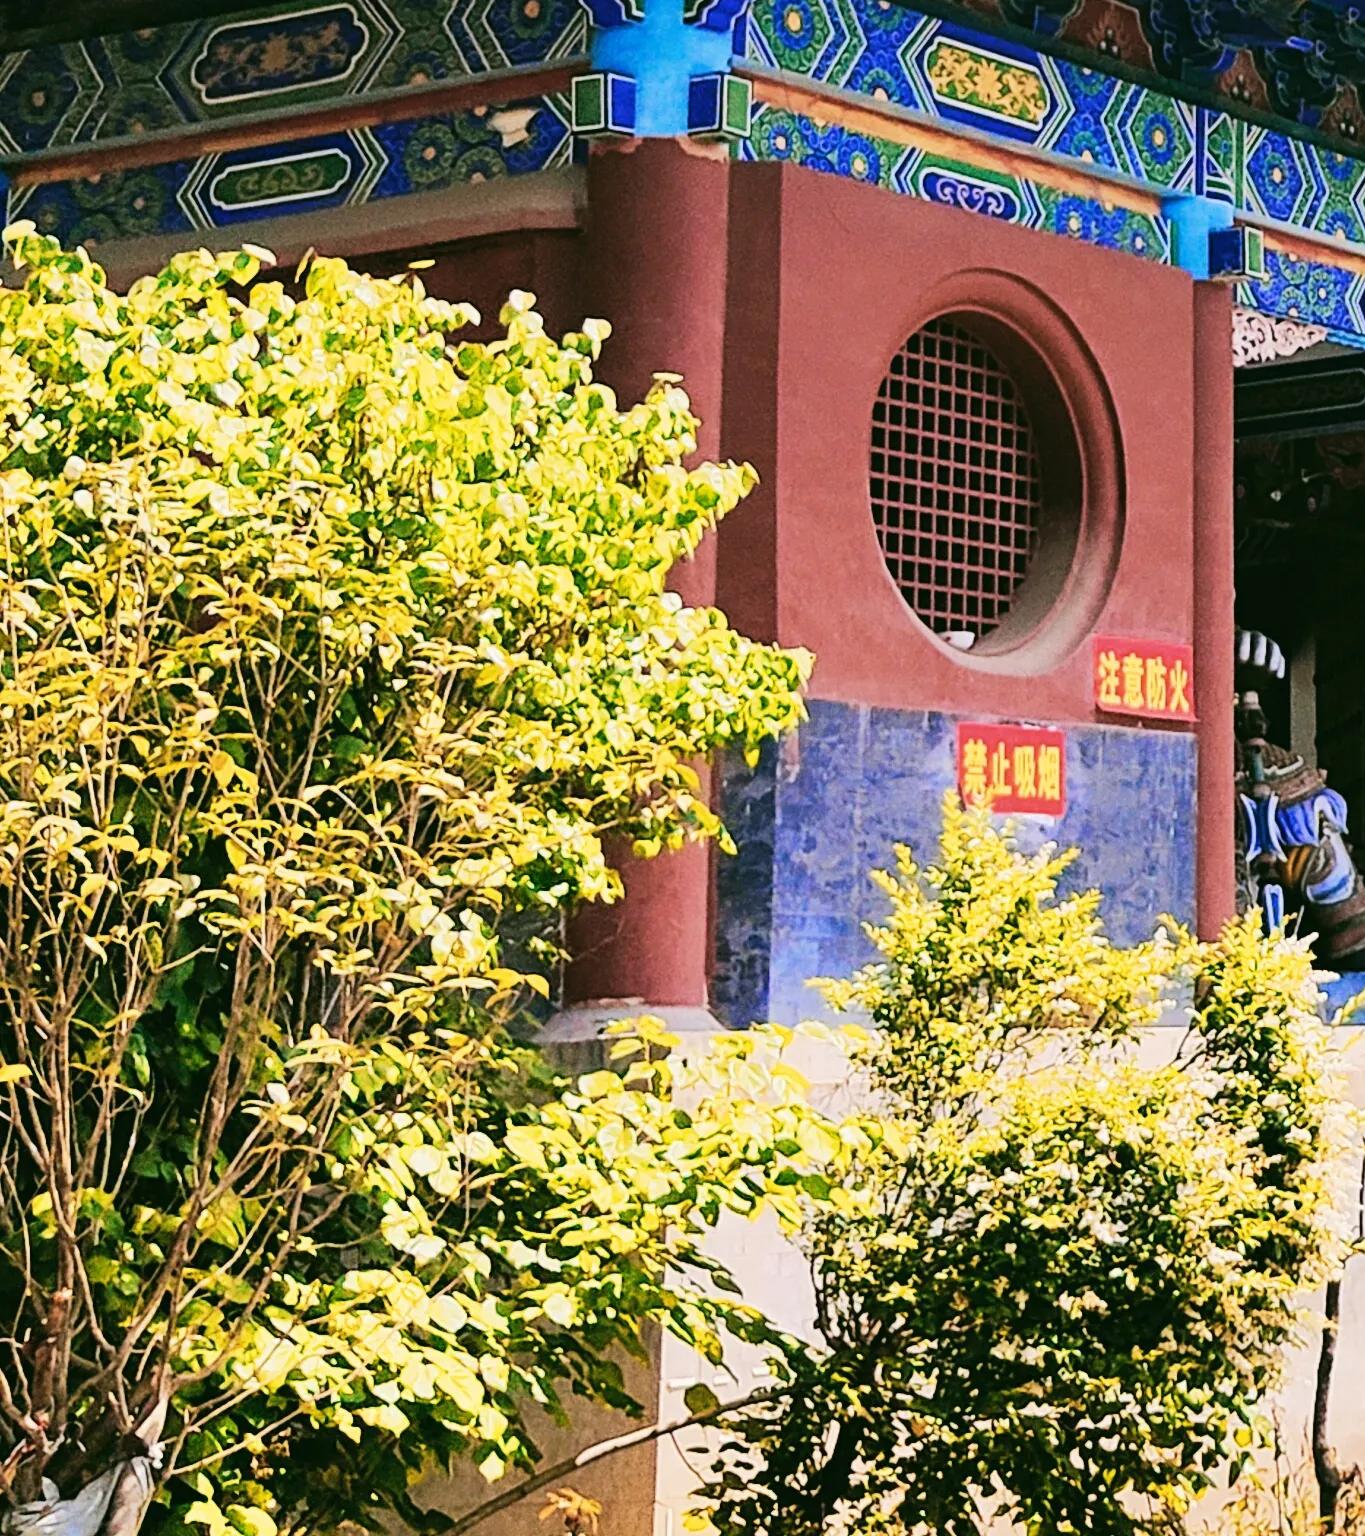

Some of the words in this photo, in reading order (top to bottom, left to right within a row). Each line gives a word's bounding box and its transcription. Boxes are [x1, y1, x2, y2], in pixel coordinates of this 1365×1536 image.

[1097, 650, 1190, 713] 注意防火
[963, 738, 1062, 801] 禁止吸烟
